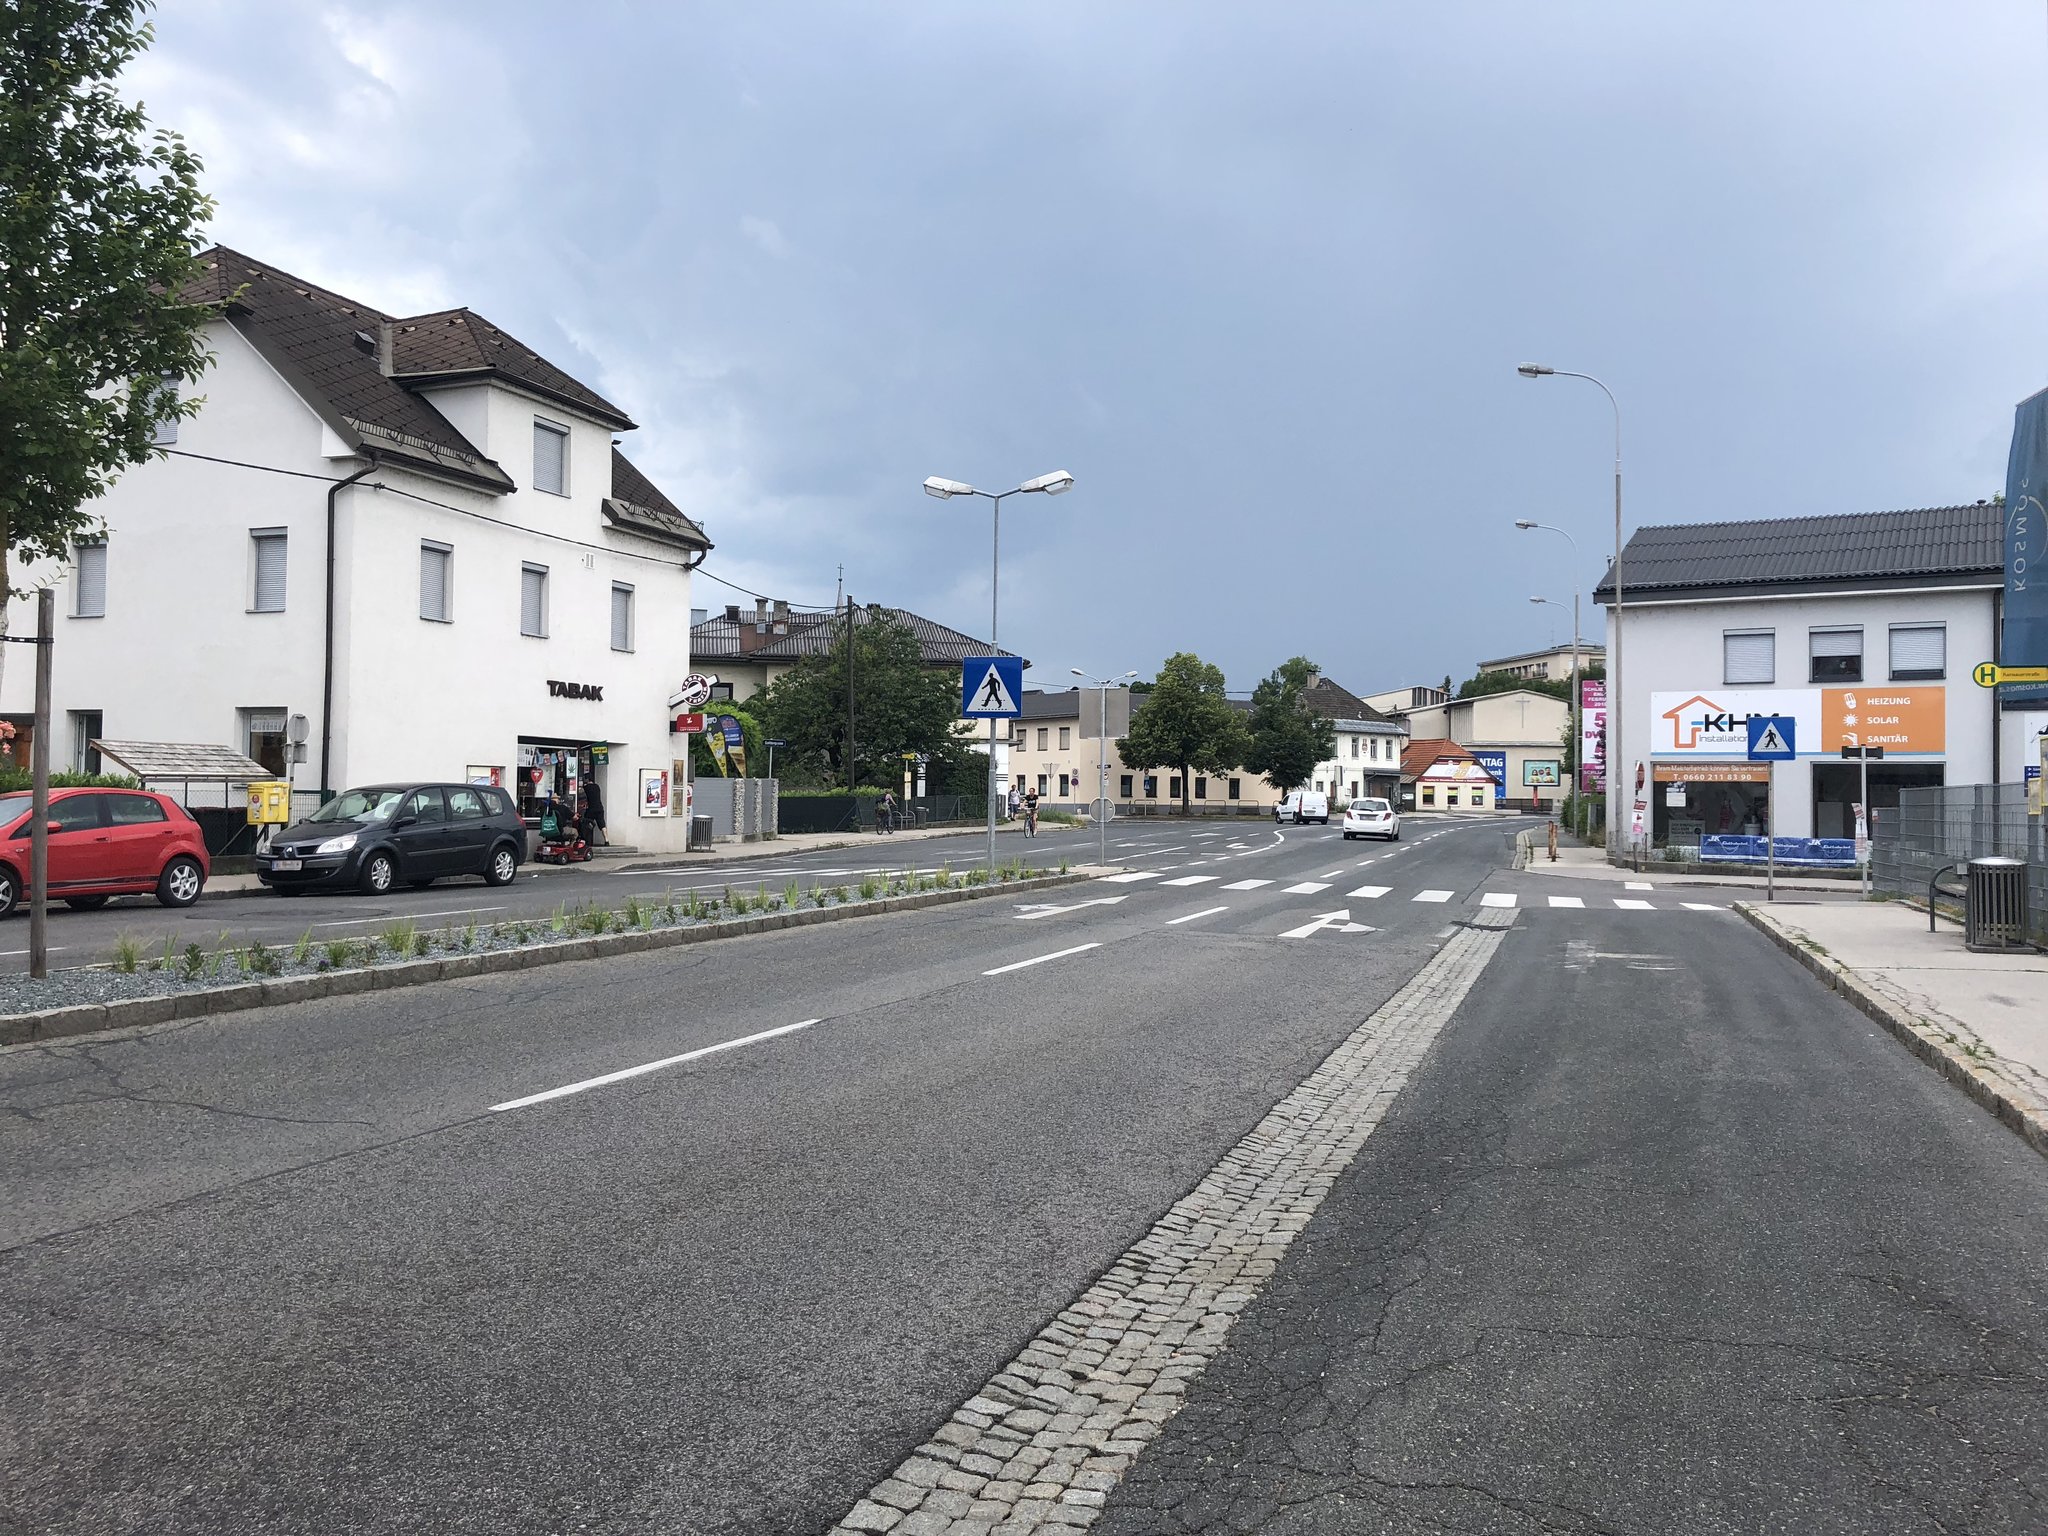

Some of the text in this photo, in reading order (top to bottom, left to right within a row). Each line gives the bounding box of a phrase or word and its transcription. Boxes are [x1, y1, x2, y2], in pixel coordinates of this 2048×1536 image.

[682, 675, 702, 690] TABAK
[547, 680, 604, 701] TABAK
[1867, 697, 1911, 705] HEIZUNG
[1867, 716, 1899, 724] SOLAR
[1867, 733, 1909, 743] SANITÄR
[1479, 757, 1504, 767] NTAG
